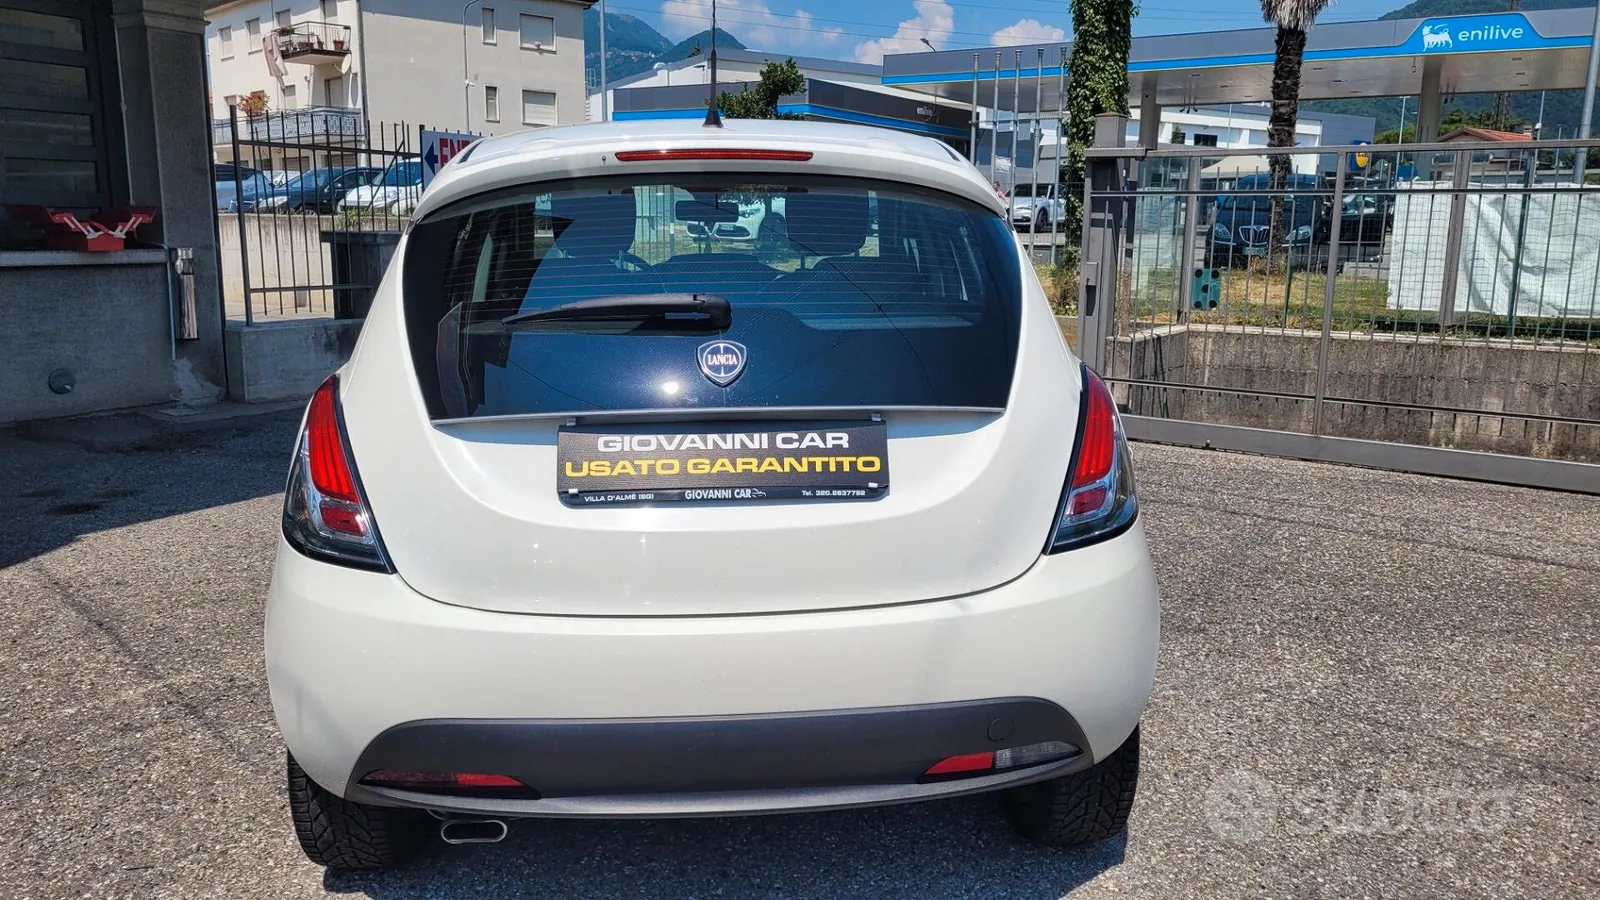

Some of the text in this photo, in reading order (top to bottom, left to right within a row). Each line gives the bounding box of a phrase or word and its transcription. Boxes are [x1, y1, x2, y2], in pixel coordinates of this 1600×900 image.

[1458, 25, 1523, 41] enilive
[707, 354, 738, 365] LANCIA
[597, 432, 849, 452] GIOVANNI CAR
[565, 456, 881, 478] USATO GARANTITO
[685, 488, 751, 500] GIOVANNI CAR
